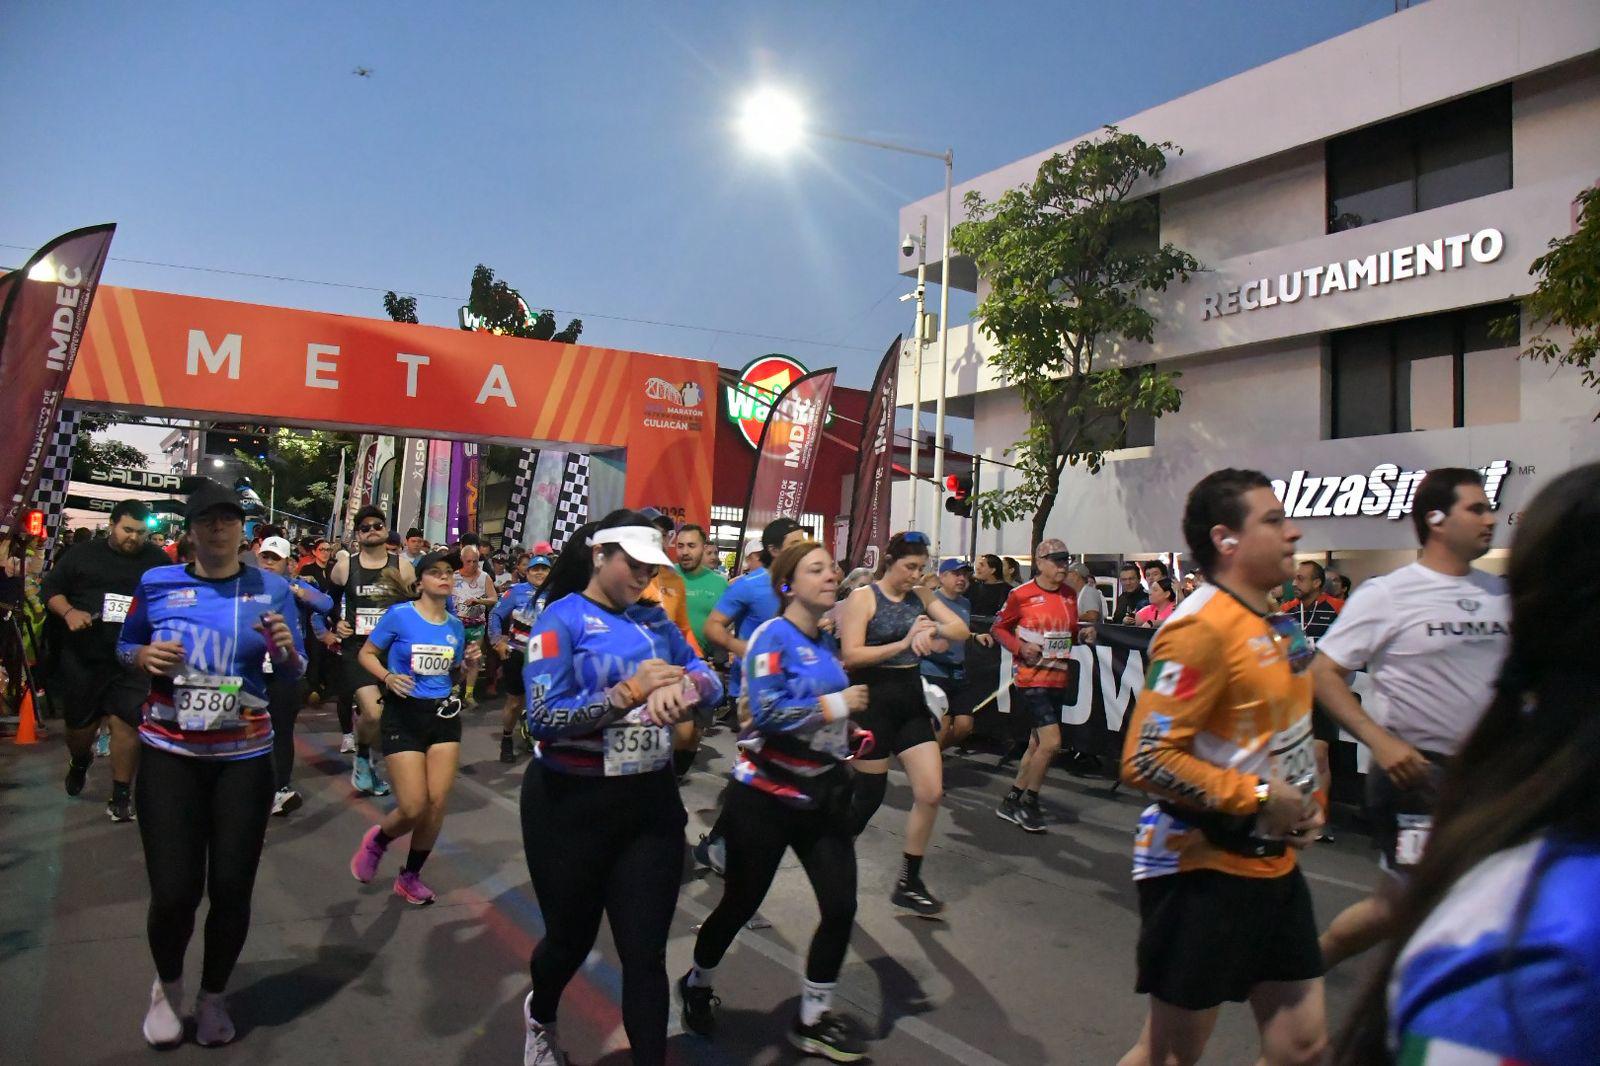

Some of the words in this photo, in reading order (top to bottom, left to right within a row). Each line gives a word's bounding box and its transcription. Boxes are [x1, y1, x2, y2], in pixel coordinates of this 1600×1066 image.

[1202, 228, 1503, 320] RECLUTAMIENTO
[46, 264, 82, 371] IMDEC
[186, 329, 517, 408] META
[643, 417, 689, 430] CULIACÁN
[784, 398, 811, 468] IMDEC
[91, 467, 181, 489] SALIDA
[1518, 465, 1536, 475] MR
[782, 480, 798, 518] ACÁN
[1426, 621, 1508, 637] HUMA
[418, 655, 450, 671] 1000
[178, 690, 238, 713] 3580
[613, 729, 661, 754] 3531
